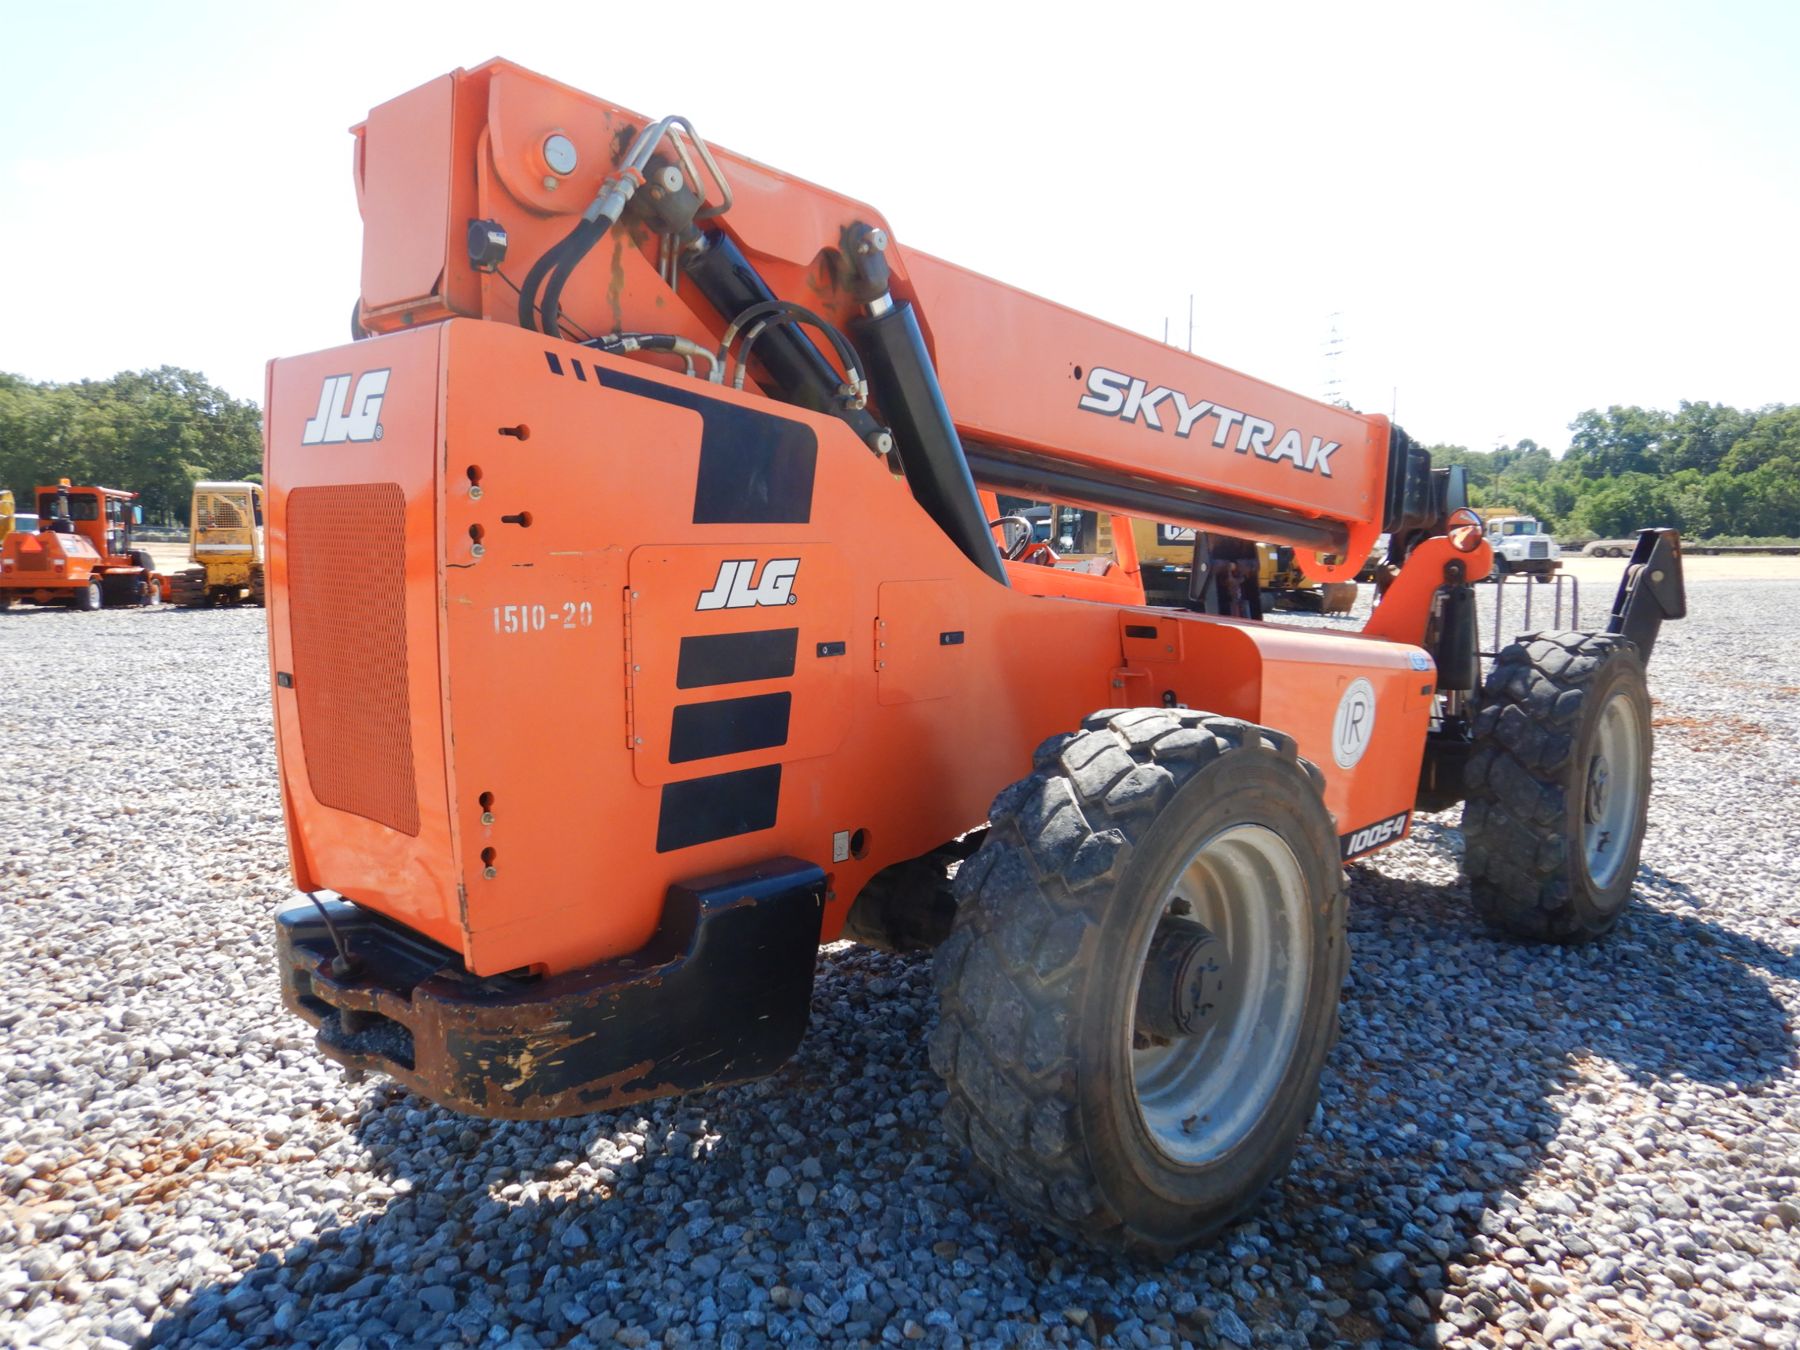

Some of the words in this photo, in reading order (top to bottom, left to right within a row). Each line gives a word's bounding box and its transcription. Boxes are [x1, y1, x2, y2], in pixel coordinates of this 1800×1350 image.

[301, 367, 391, 446] JLG
[1078, 367, 1342, 478] SKYTRAK
[695, 558, 800, 611] JLG
[493, 601, 593, 634] 1510-20
[1346, 814, 1406, 855] 10054
